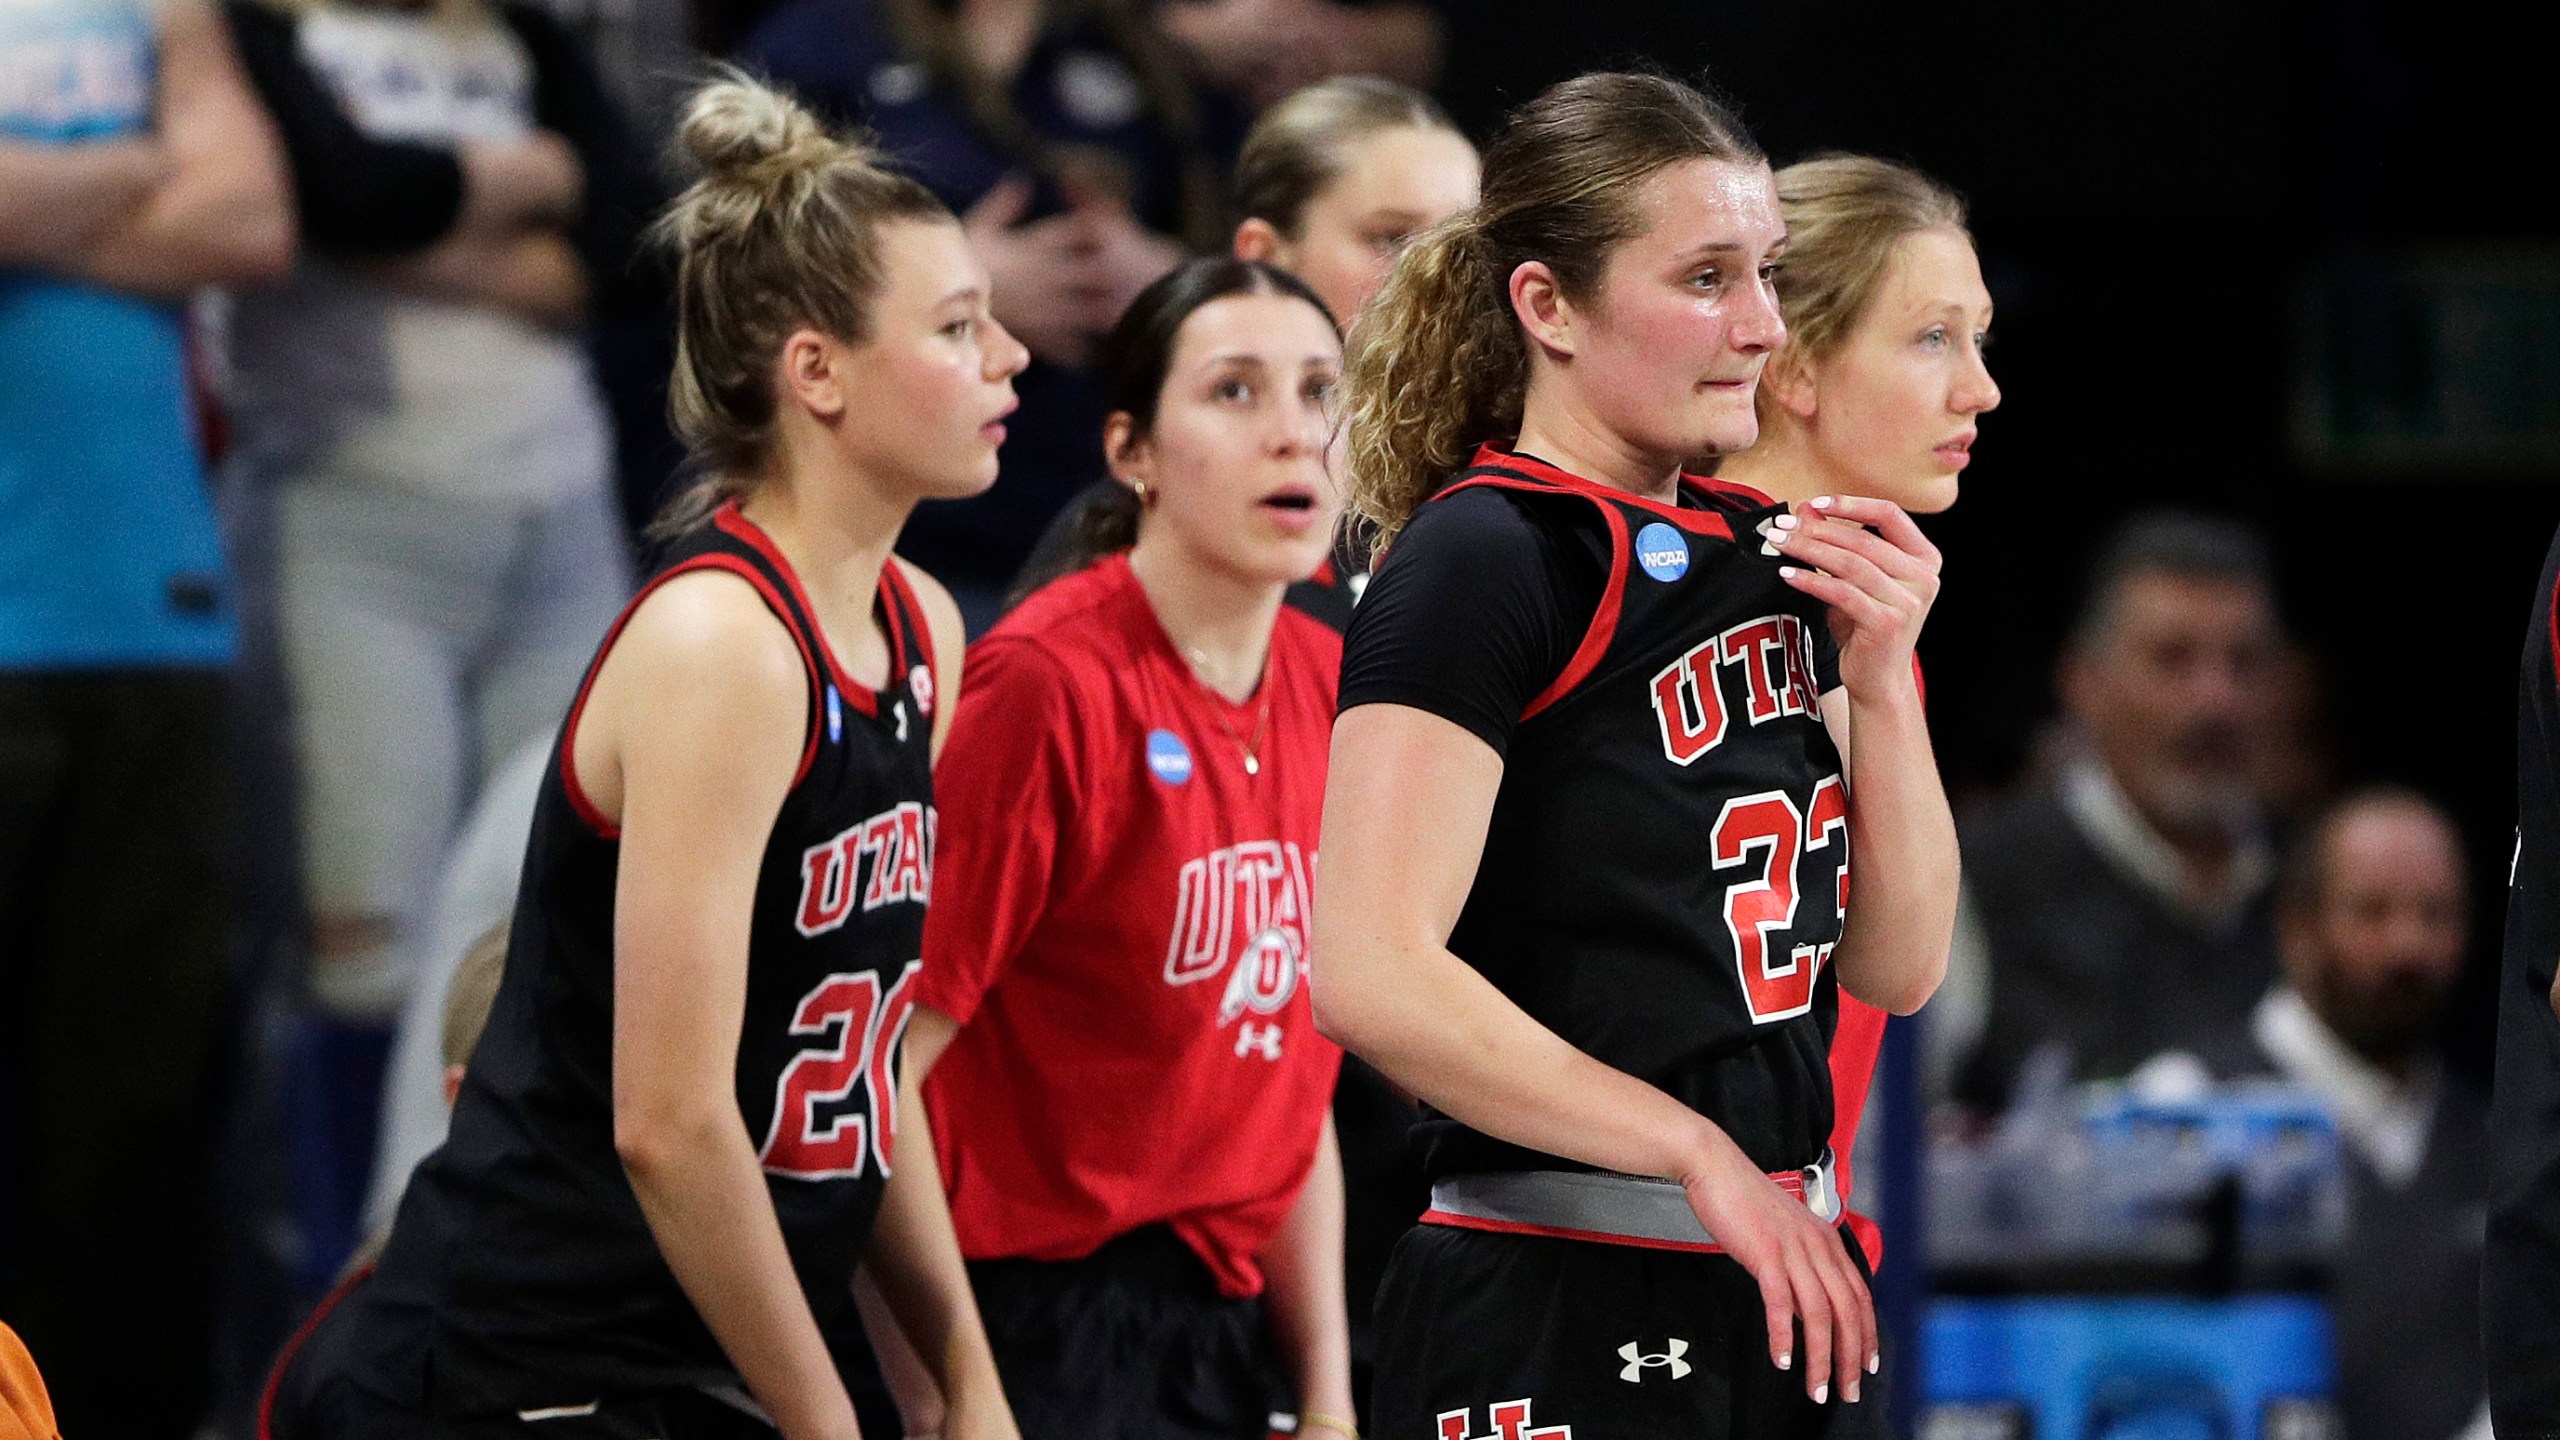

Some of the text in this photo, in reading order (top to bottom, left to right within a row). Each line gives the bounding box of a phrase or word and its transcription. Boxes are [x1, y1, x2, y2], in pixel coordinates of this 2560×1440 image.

[1643, 550, 1687, 568] NCAA
[1650, 613, 1822, 767] UTA
[795, 801, 938, 938] UTA
[1163, 839, 1320, 987] UTA
